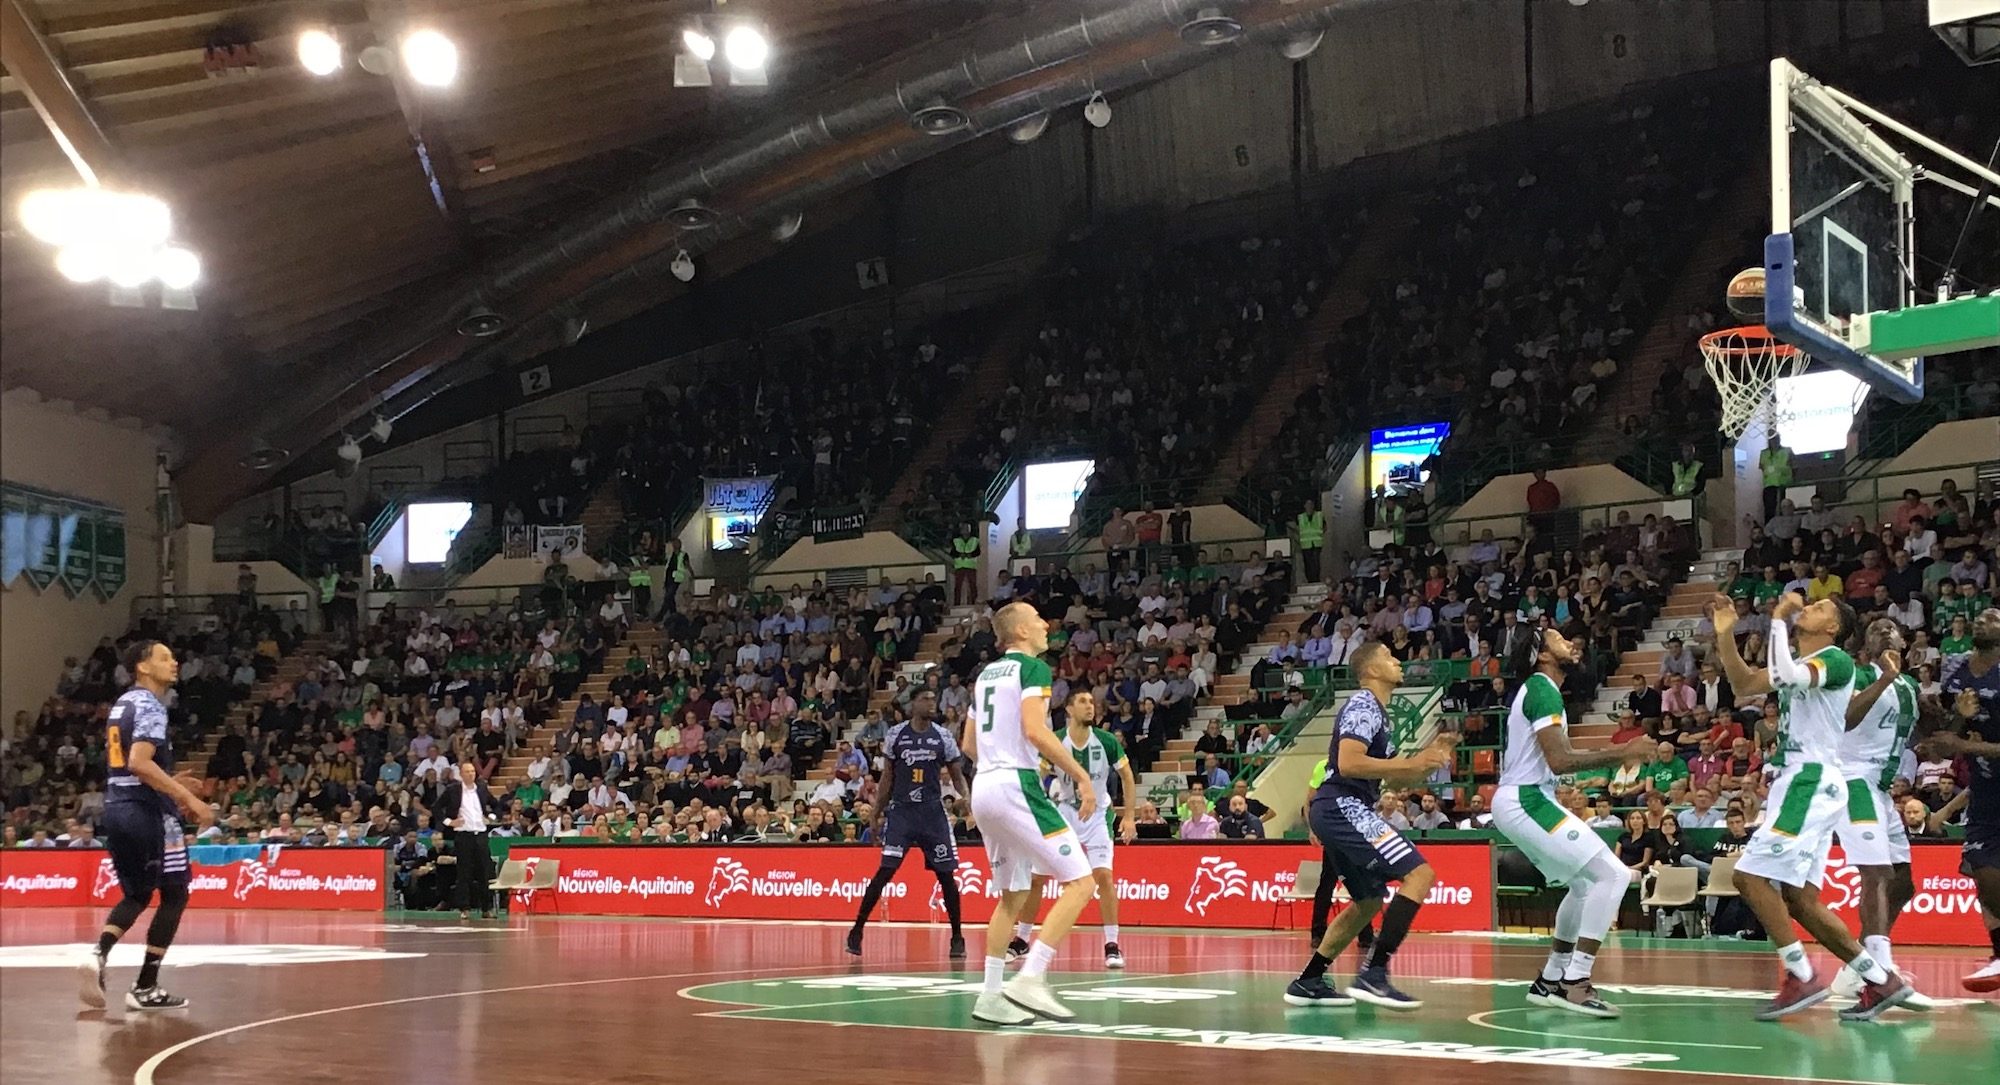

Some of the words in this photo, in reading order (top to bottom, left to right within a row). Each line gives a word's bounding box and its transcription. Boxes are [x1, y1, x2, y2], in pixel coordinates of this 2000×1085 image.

[1235, 145, 1249, 167] 6
[866, 265, 880, 284] 4
[528, 370, 543, 391] 2
[982, 686, 995, 733] 5
[912, 768, 924, 783] 31
[572, 869, 599, 878] RÉGION
[767, 870, 796, 880] RÉGION
[268, 874, 377, 895] Nouvelle-Aquitaine
[558, 875, 695, 899] Nouvelle-Aquitaine
